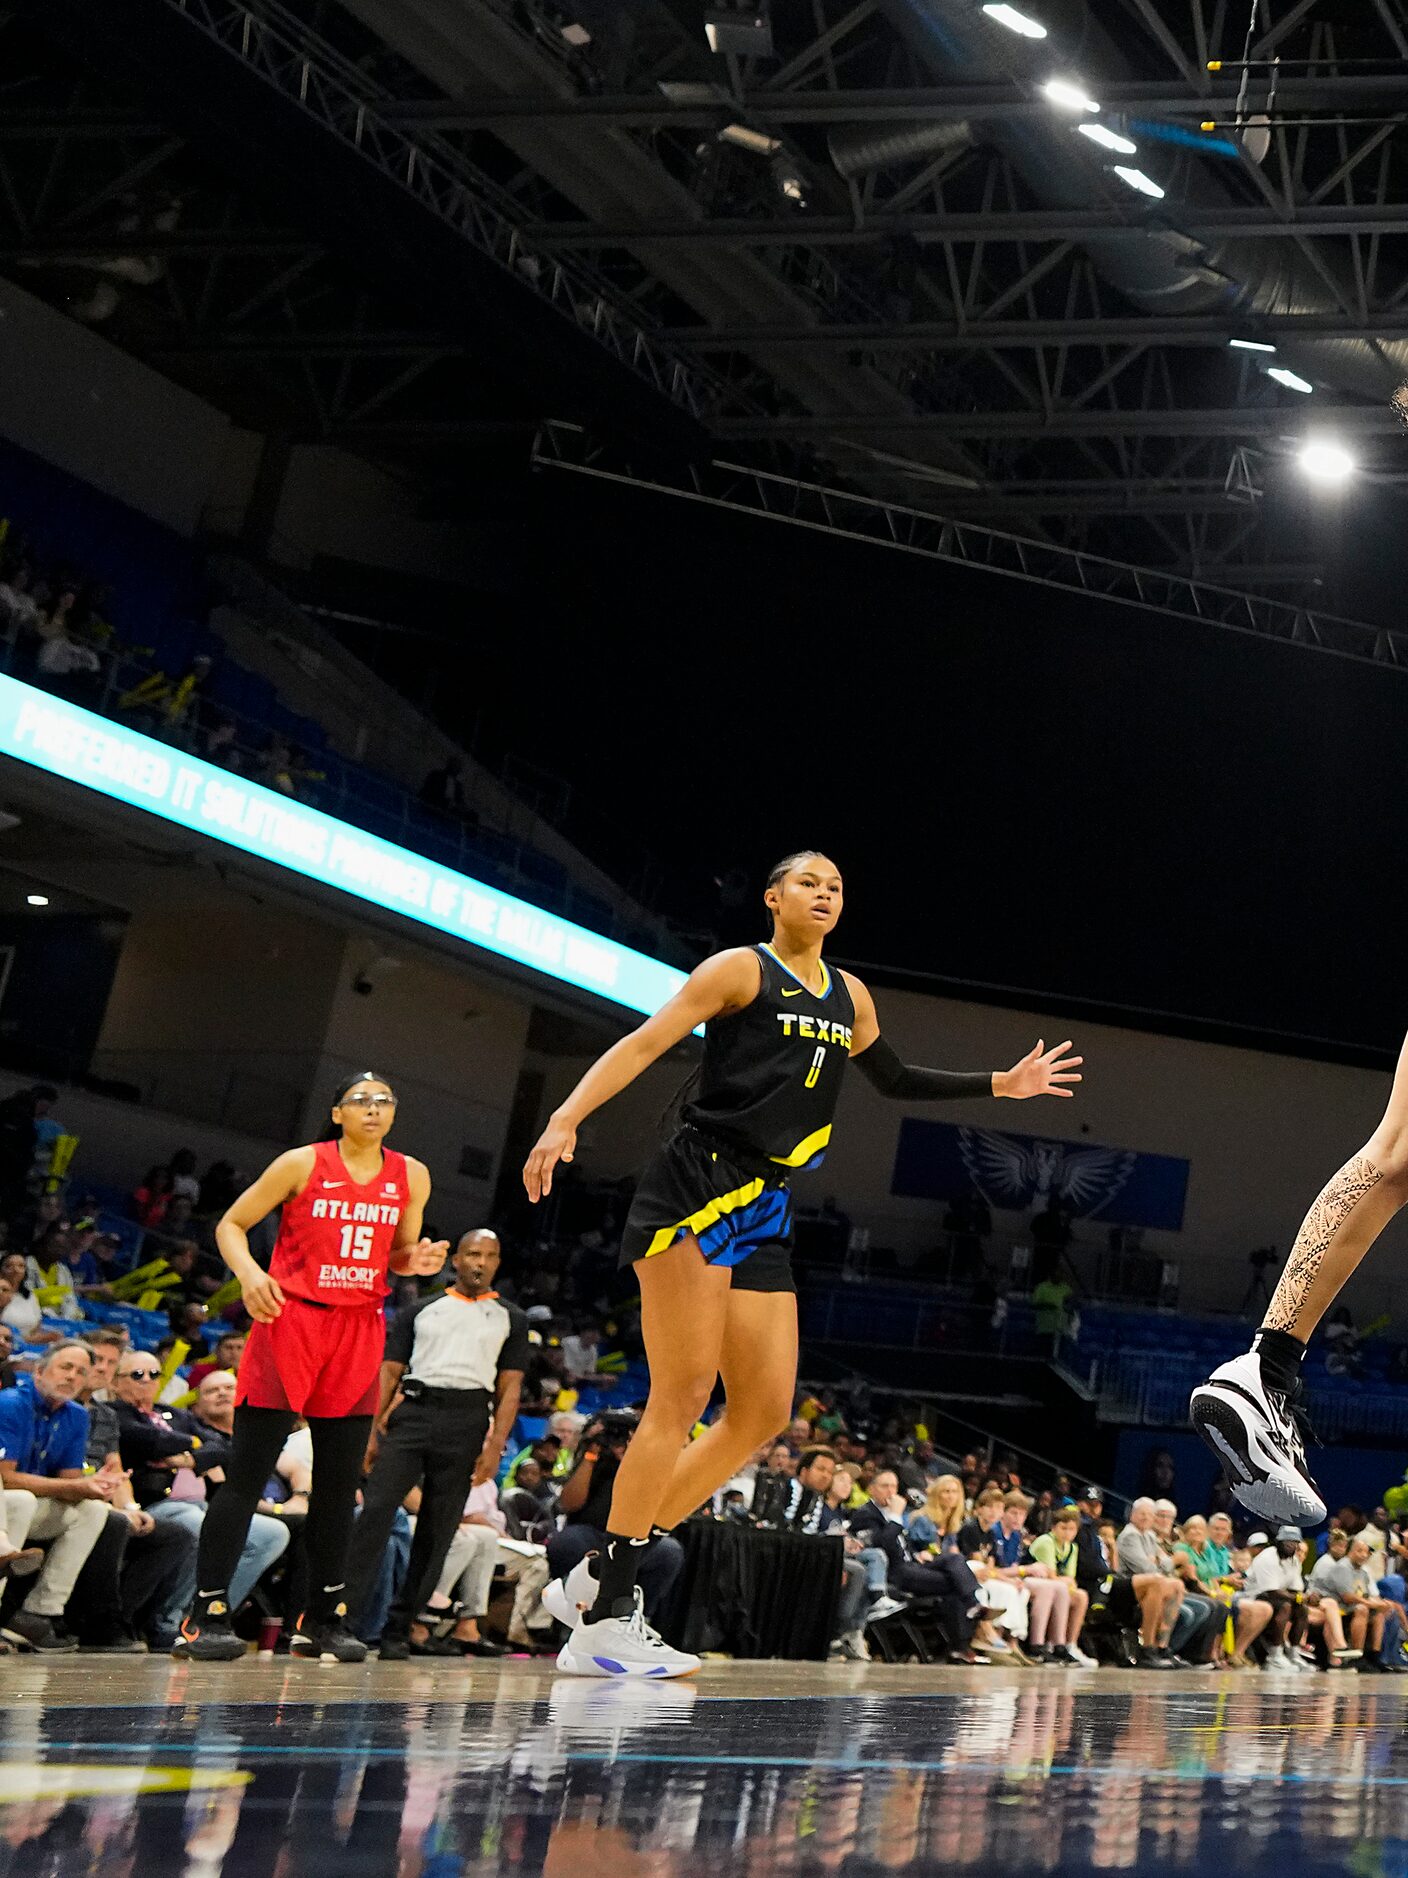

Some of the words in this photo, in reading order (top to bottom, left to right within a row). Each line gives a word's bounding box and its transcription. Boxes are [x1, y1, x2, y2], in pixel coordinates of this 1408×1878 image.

[169, 765, 204, 811] IT
[777, 1013, 853, 1050] TEXAS
[804, 1045, 827, 1089] 0
[312, 1198, 400, 1226] ATLANTA
[340, 1224, 375, 1261] 15
[319, 1263, 380, 1283] EMORY
